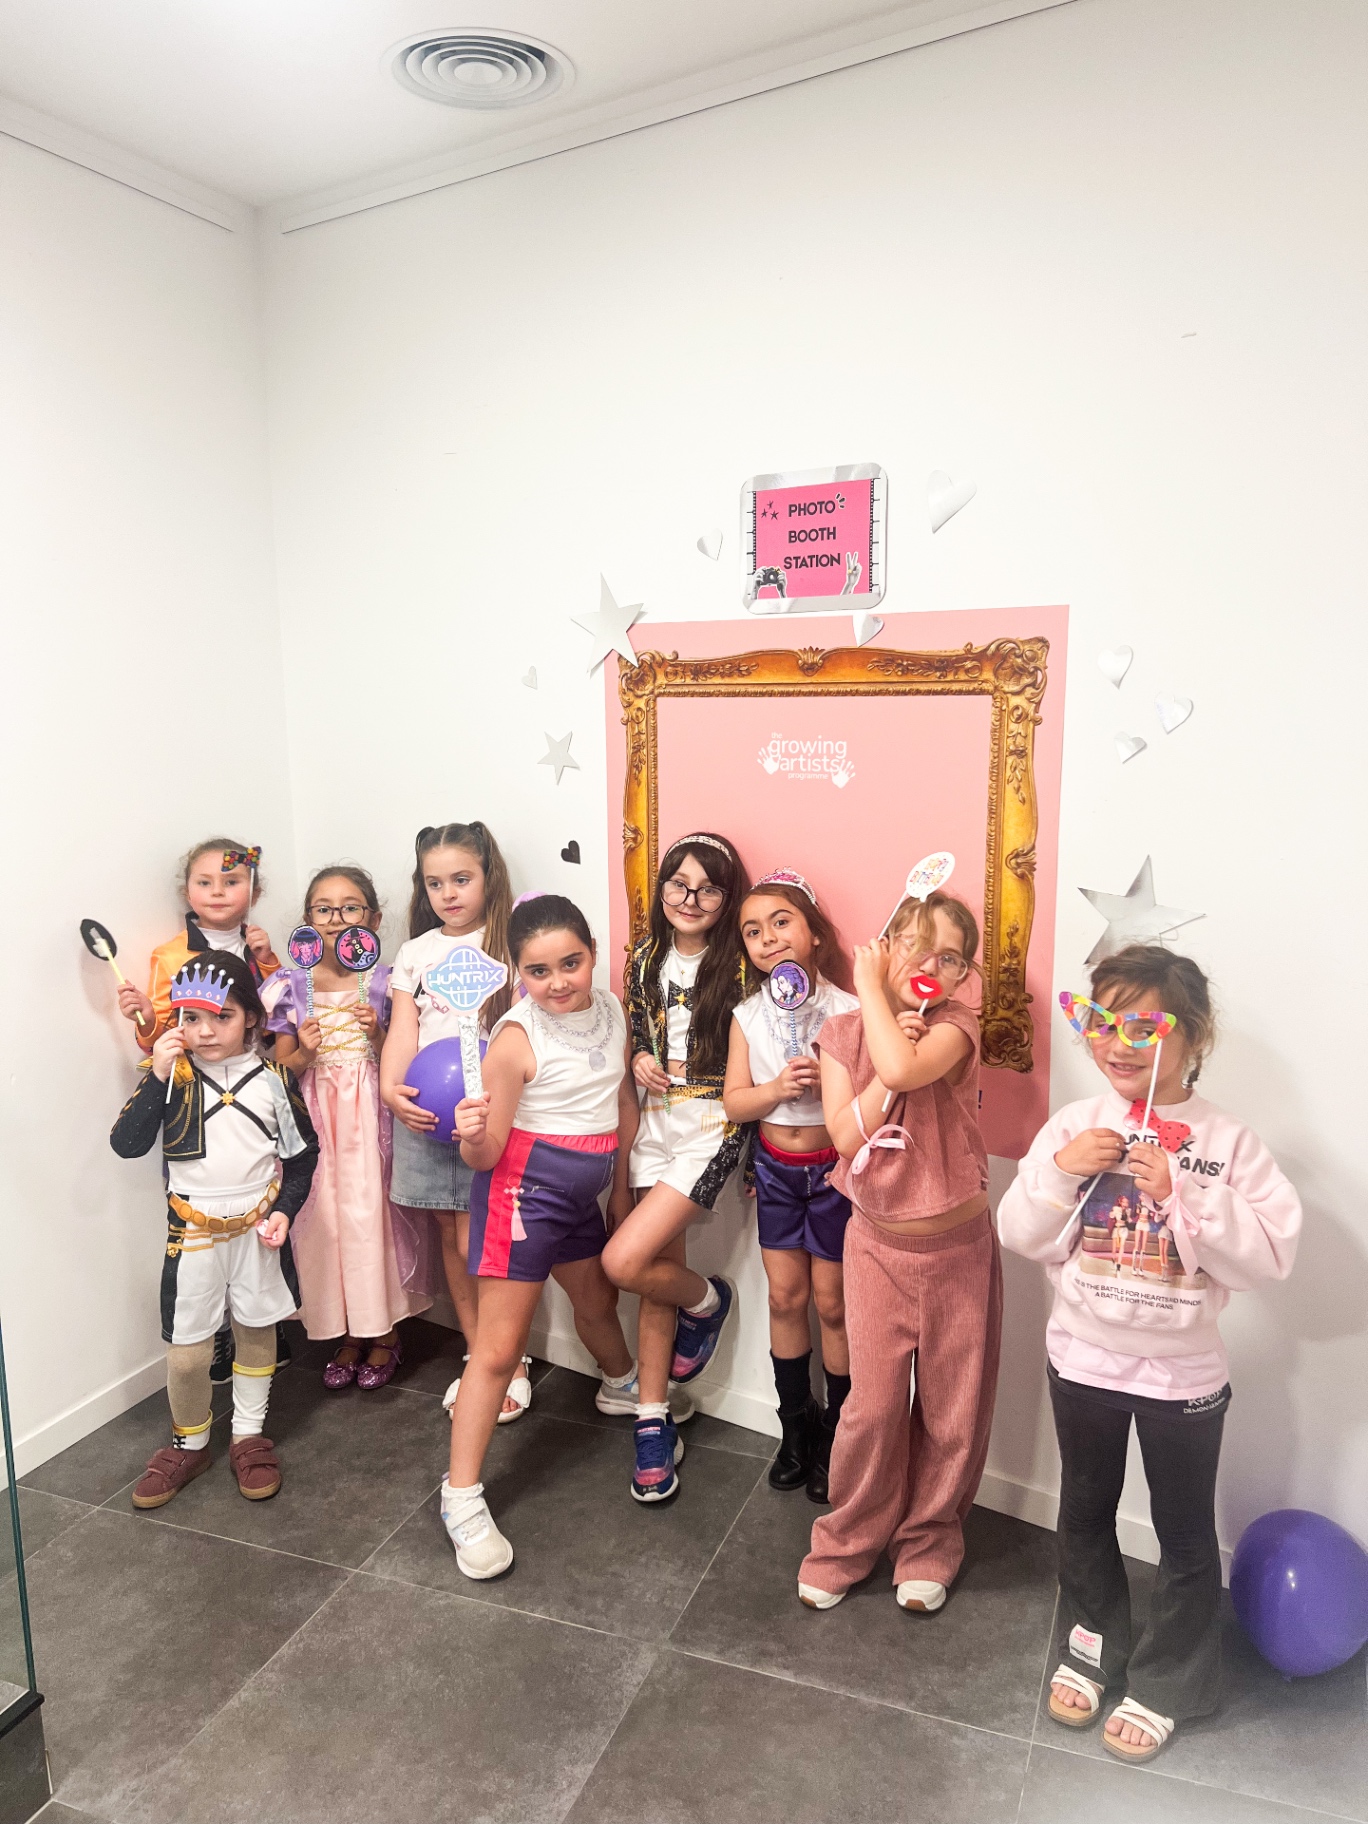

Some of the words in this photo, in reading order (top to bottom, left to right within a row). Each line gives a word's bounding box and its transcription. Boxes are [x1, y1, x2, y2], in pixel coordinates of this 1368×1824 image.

[788, 500, 836, 517] PHOTO
[788, 526, 837, 544] BOOTH
[783, 553, 841, 570] STATION
[769, 735, 847, 759] growing
[779, 753, 841, 772] artists
[788, 772, 829, 780] programme
[428, 969, 503, 988] HUNTRIX
[1086, 1282, 1100, 1291] THE
[1100, 1284, 1125, 1295] BATTLE
[1125, 1289, 1140, 1298] FOR
[1100, 1291, 1125, 1302] BATTLE
[1140, 1299, 1155, 1307] THE
